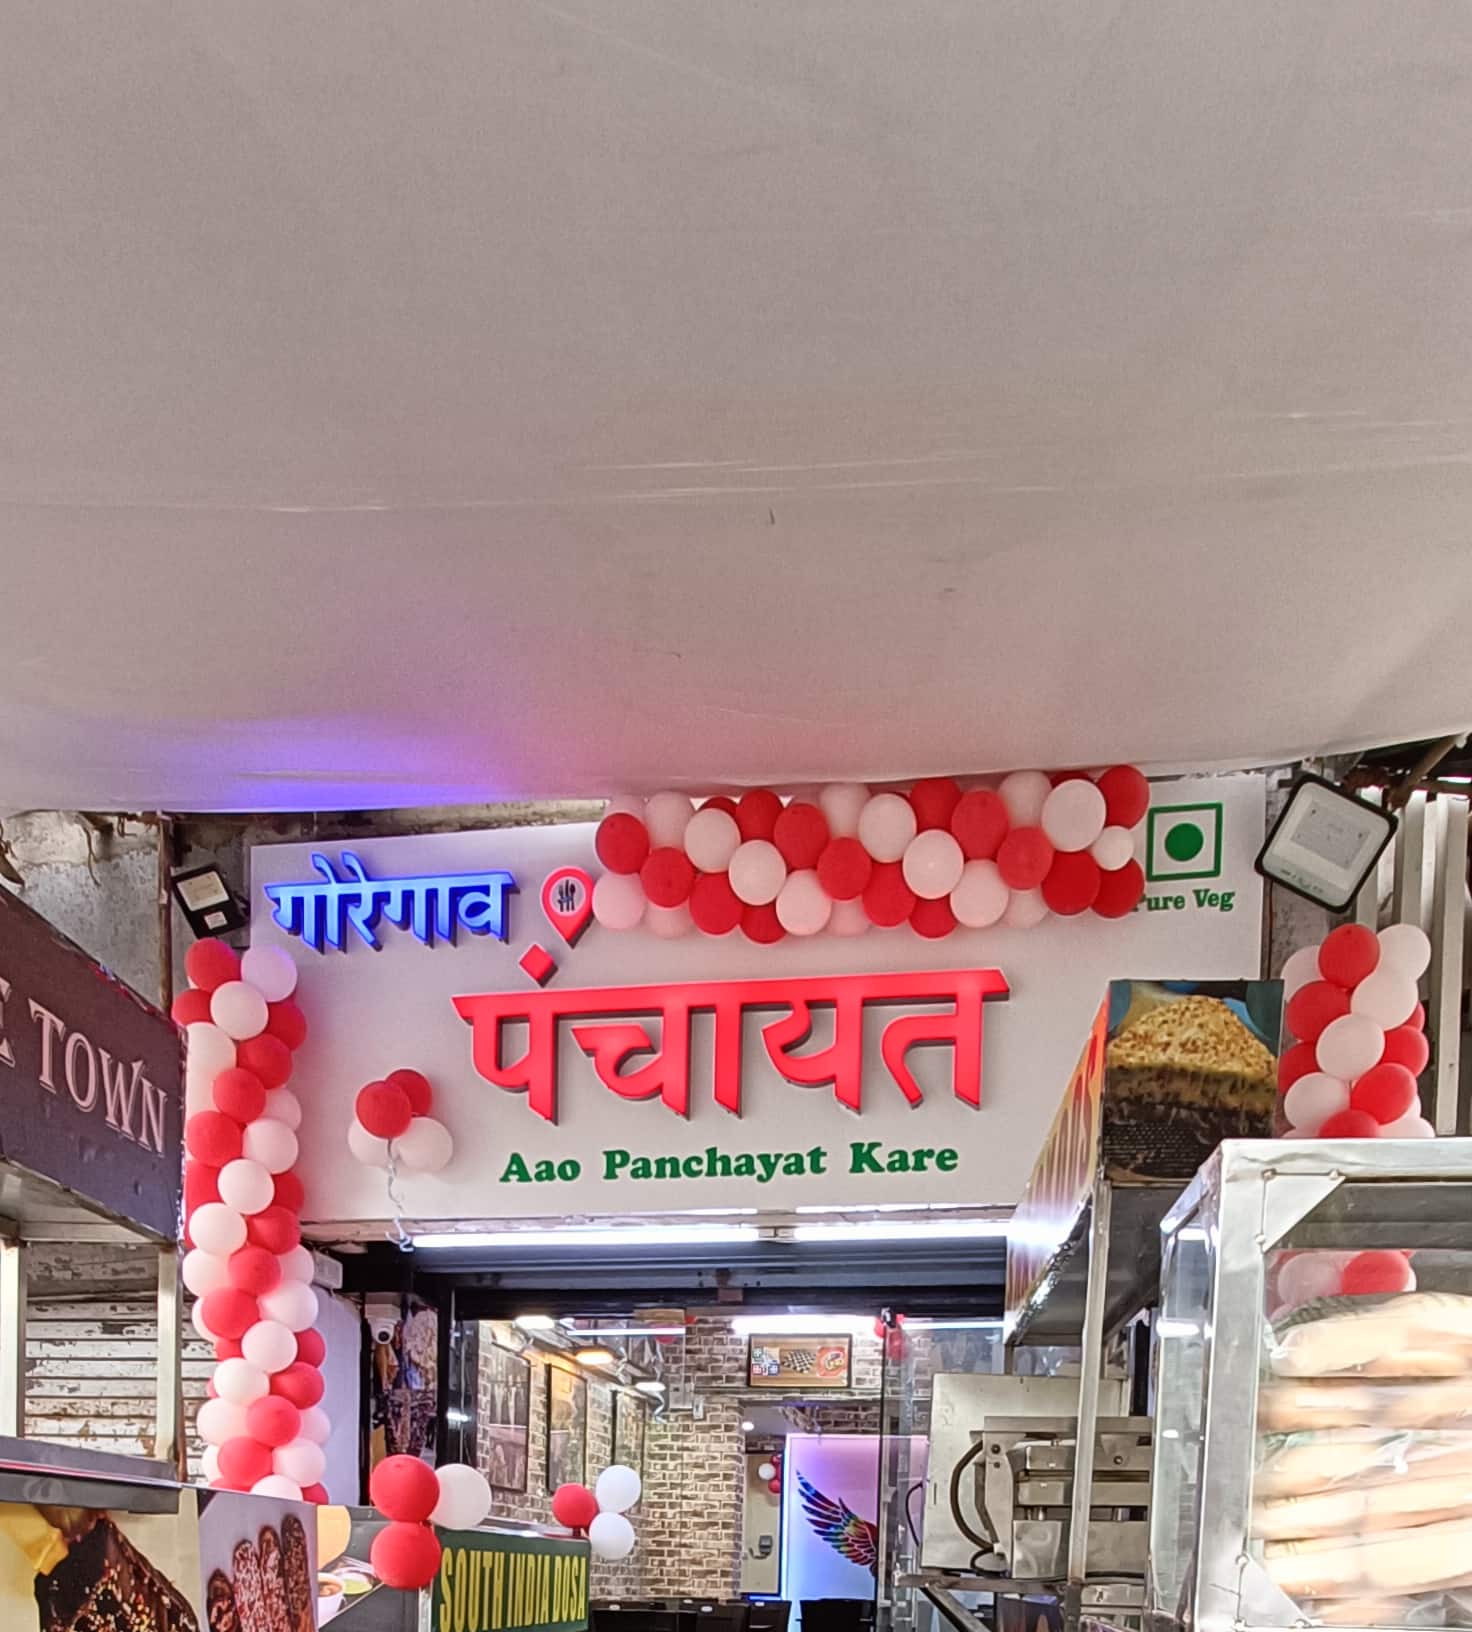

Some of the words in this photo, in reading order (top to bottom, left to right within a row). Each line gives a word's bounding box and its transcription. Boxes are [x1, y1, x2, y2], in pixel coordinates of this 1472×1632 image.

[264, 851, 515, 952] गोरेगाव
[1132, 893, 1186, 912] ure
[1192, 888, 1235, 912] Veg
[451, 943, 1010, 1124] पंचायत
[28, 998, 168, 1158] TOWN
[499, 1152, 582, 1183] Aao
[602, 1146, 828, 1183] Panchayat
[848, 1141, 960, 1173] Kare
[507, 1552, 550, 1628] INDIA
[552, 1555, 586, 1623] DOSA
